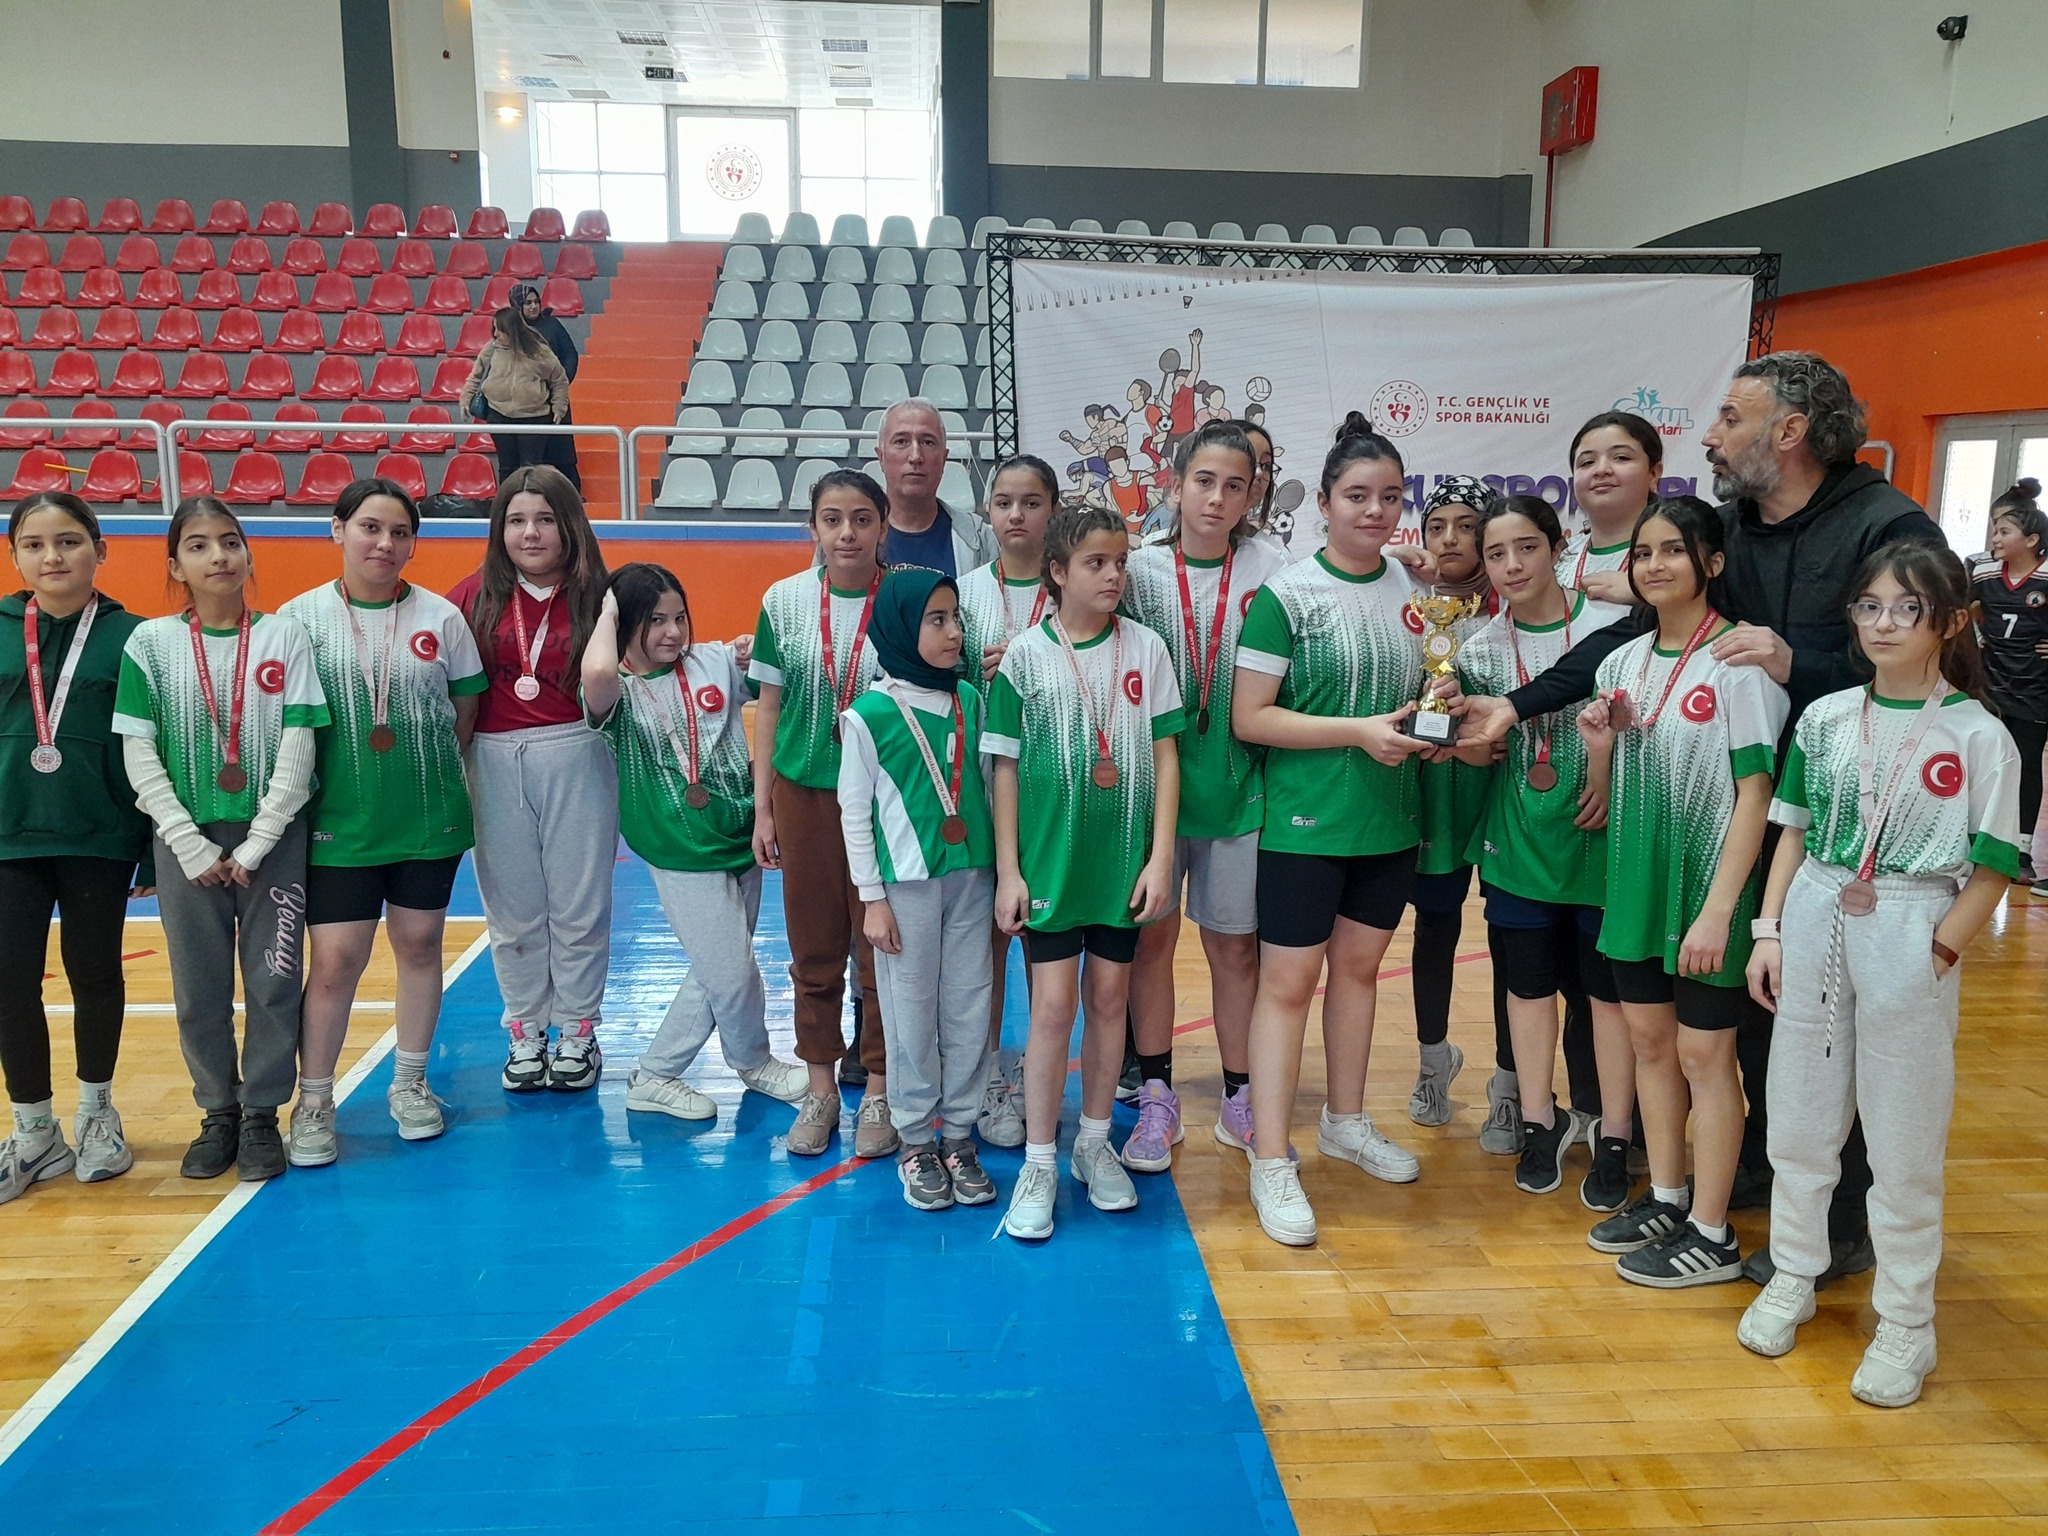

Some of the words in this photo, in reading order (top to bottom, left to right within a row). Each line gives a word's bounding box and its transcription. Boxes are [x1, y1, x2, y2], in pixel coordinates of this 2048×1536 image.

[1436, 396, 1461, 408] T.C.
[1466, 395, 1528, 411] GENÇLİK
[1533, 397, 1550, 408] VE
[1436, 411, 1472, 423] SPOR
[1475, 411, 1550, 424] BAKANLIĞI
[2002, 613, 2019, 639] 7
[264, 883, 307, 979] Beauty
